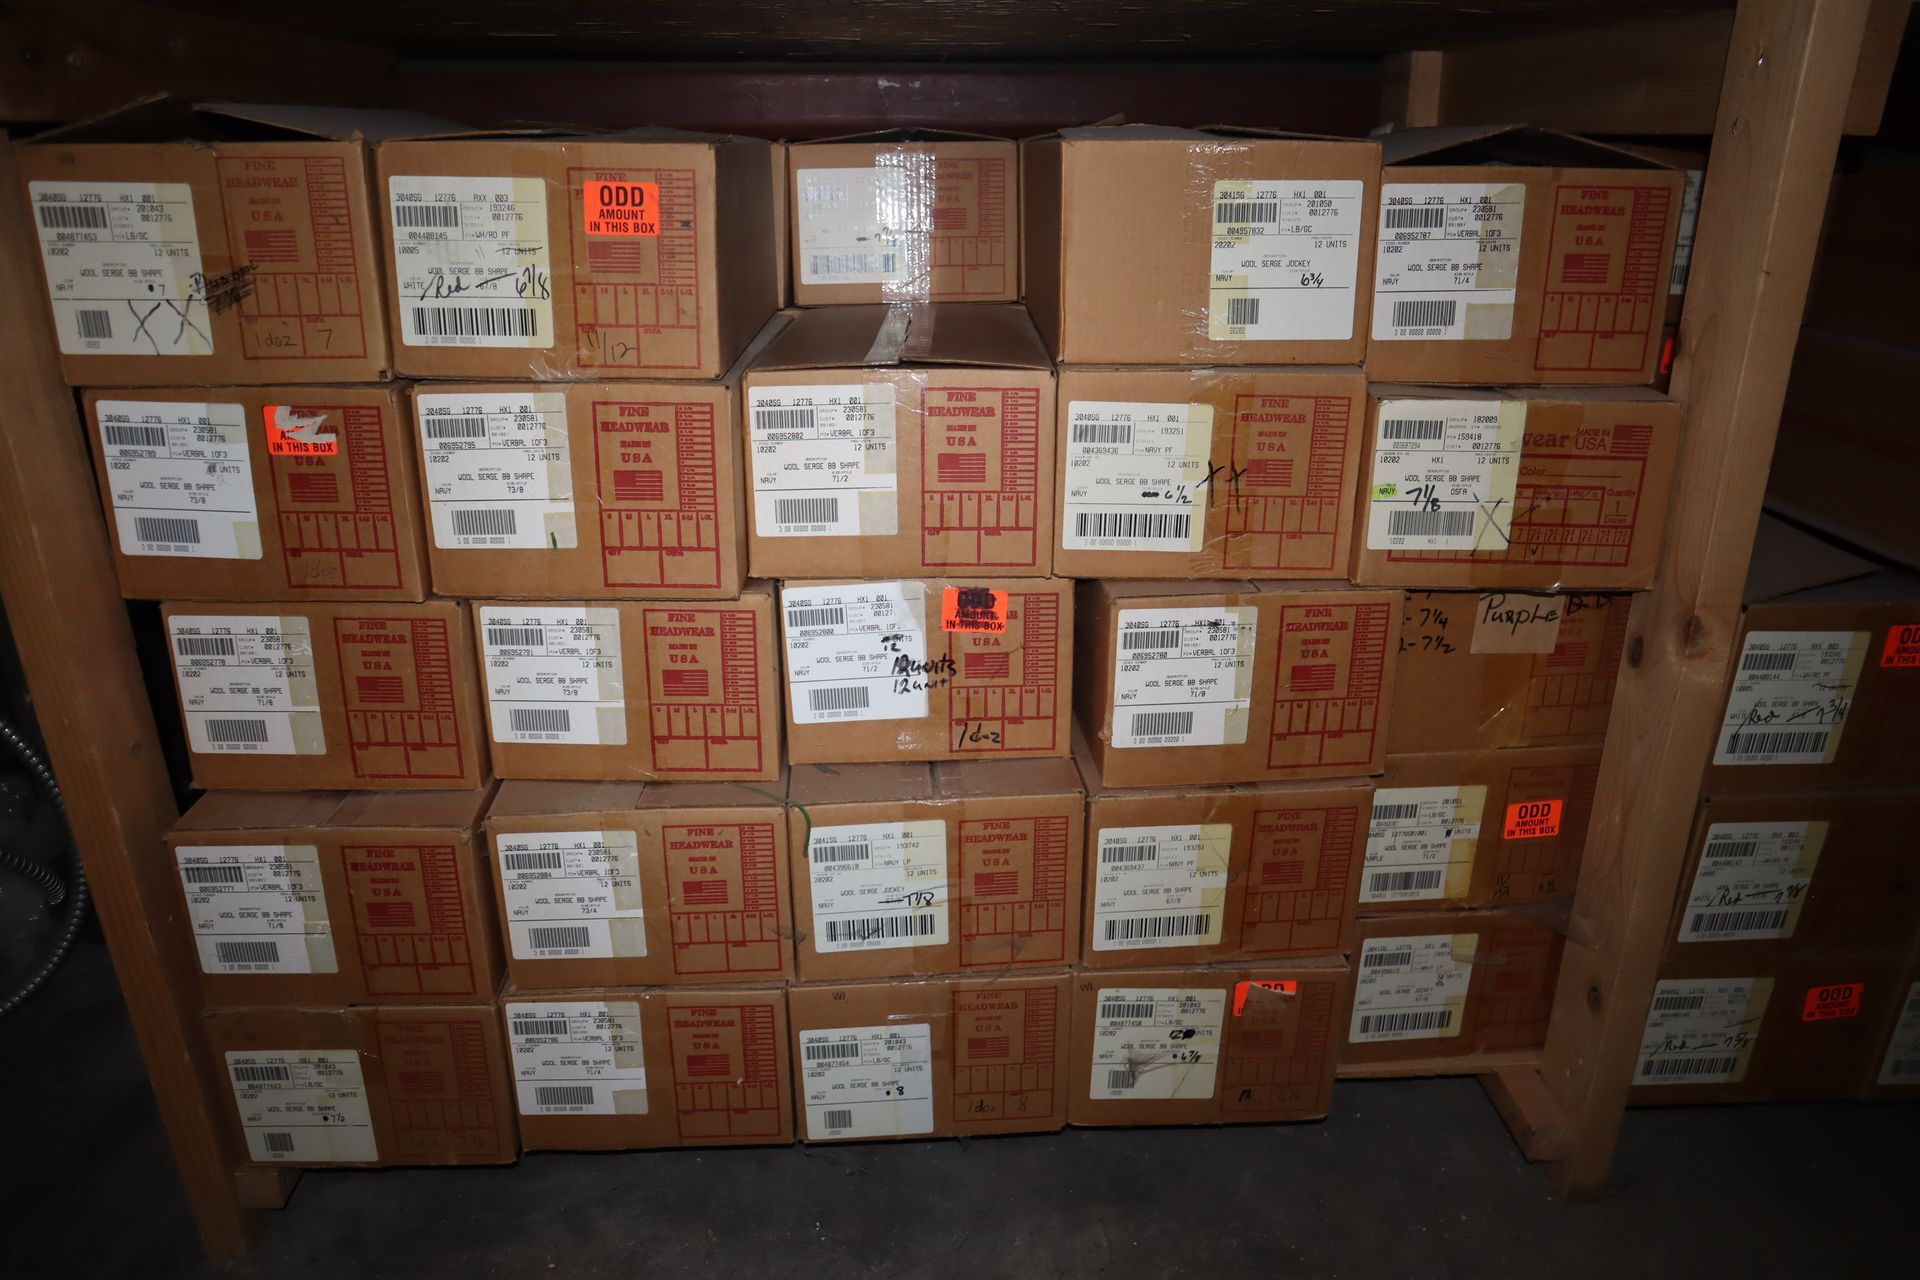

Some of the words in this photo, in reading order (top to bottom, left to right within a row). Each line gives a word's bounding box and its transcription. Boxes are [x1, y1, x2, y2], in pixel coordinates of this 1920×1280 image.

[245, 161, 276, 171] FINE
[225, 178, 299, 188] HEADWEAR
[600, 185, 644, 207] ODD
[1256, 190, 1277, 199] 12776
[1294, 190, 1306, 199] HX1
[1314, 190, 1326, 199] 001
[1582, 191, 1609, 201] FINE
[251, 211, 284, 221] USA
[599, 210, 645, 220] AMOUNT
[1309, 208, 1338, 217] 0012776
[1561, 206, 1625, 216] HEADWEAR
[590, 222, 600, 232] IN
[605, 222, 628, 232] THIS
[634, 222, 655, 233] BOX
[1215, 241, 1235, 249] 20202
[1314, 240, 1322, 249] 12
[1326, 240, 1347, 249] UNITS
[1576, 237, 1603, 247] USA
[1241, 260, 1257, 268] WOOL
[1262, 260, 1282, 268] SERGE
[1286, 259, 1311, 268] JOCKEY
[1407, 263, 1423, 272] WOOL
[1428, 263, 1446, 272] SERGE
[1451, 263, 1459, 272] BB
[1463, 263, 1483, 271] SHAPE
[1216, 274, 1232, 282] NAVY
[1383, 277, 1399, 286] NAVY
[404, 281, 425, 290] WHITE
[947, 392, 976, 402] FINE
[1261, 399, 1289, 409] FINE
[619, 406, 649, 416] FINE
[928, 406, 996, 417] HEADWEAR
[1241, 413, 1308, 423] HEADWEAR
[600, 421, 670, 433] HEADWEAR
[1576, 428, 1600, 438] MADE
[1603, 428, 1611, 437] IN
[866, 442, 886, 451] UNITS
[946, 437, 977, 447] USA
[1257, 442, 1286, 452] USA
[1575, 438, 1606, 450] USA
[273, 443, 283, 453] IN
[287, 443, 309, 453] THIS
[314, 443, 333, 453] BOX
[621, 453, 652, 463] USA
[784, 462, 800, 471] WOOL
[804, 462, 823, 470] SERGE
[828, 461, 836, 470] BB
[840, 461, 860, 470] SHAPE
[1520, 467, 1546, 477] Color
[761, 476, 776, 485] NAVY
[1405, 474, 1420, 482] WOOL
[1425, 474, 1445, 482] SERGE
[1449, 474, 1457, 483] BB
[1461, 474, 1480, 483] SHAPE
[435, 486, 451, 495] NAVY
[1379, 487, 1396, 496] NAVY
[1607, 489, 1636, 499] Quantity
[1604, 516, 1626, 525] Dozen
[668, 613, 695, 623] FINE
[1305, 609, 1332, 618] FINE
[359, 622, 386, 631] FINE
[946, 620, 955, 629] IN
[1286, 621, 1348, 632] HEADWEAR
[651, 627, 715, 637] HEADWEAR
[342, 635, 407, 645] HEADWEAR
[973, 638, 1001, 647] USA
[669, 654, 698, 664] USA
[1301, 649, 1328, 659] USA
[362, 661, 392, 671] USA
[1121, 693, 1136, 701] NAVY
[1518, 803, 1551, 819] ODD
[983, 822, 1010, 831] FINE
[1515, 818, 1550, 828] AMOUNT
[687, 828, 714, 837] FINE
[1507, 828, 1516, 837] IN
[1519, 828, 1536, 837] THIS
[1539, 826, 1555, 835] BOX
[966, 833, 1028, 843] HEADWEAR
[670, 841, 733, 851] HEADWEAR
[982, 858, 1010, 867] USA
[690, 866, 718, 875] USA
[1818, 987, 1853, 1002] ODD
